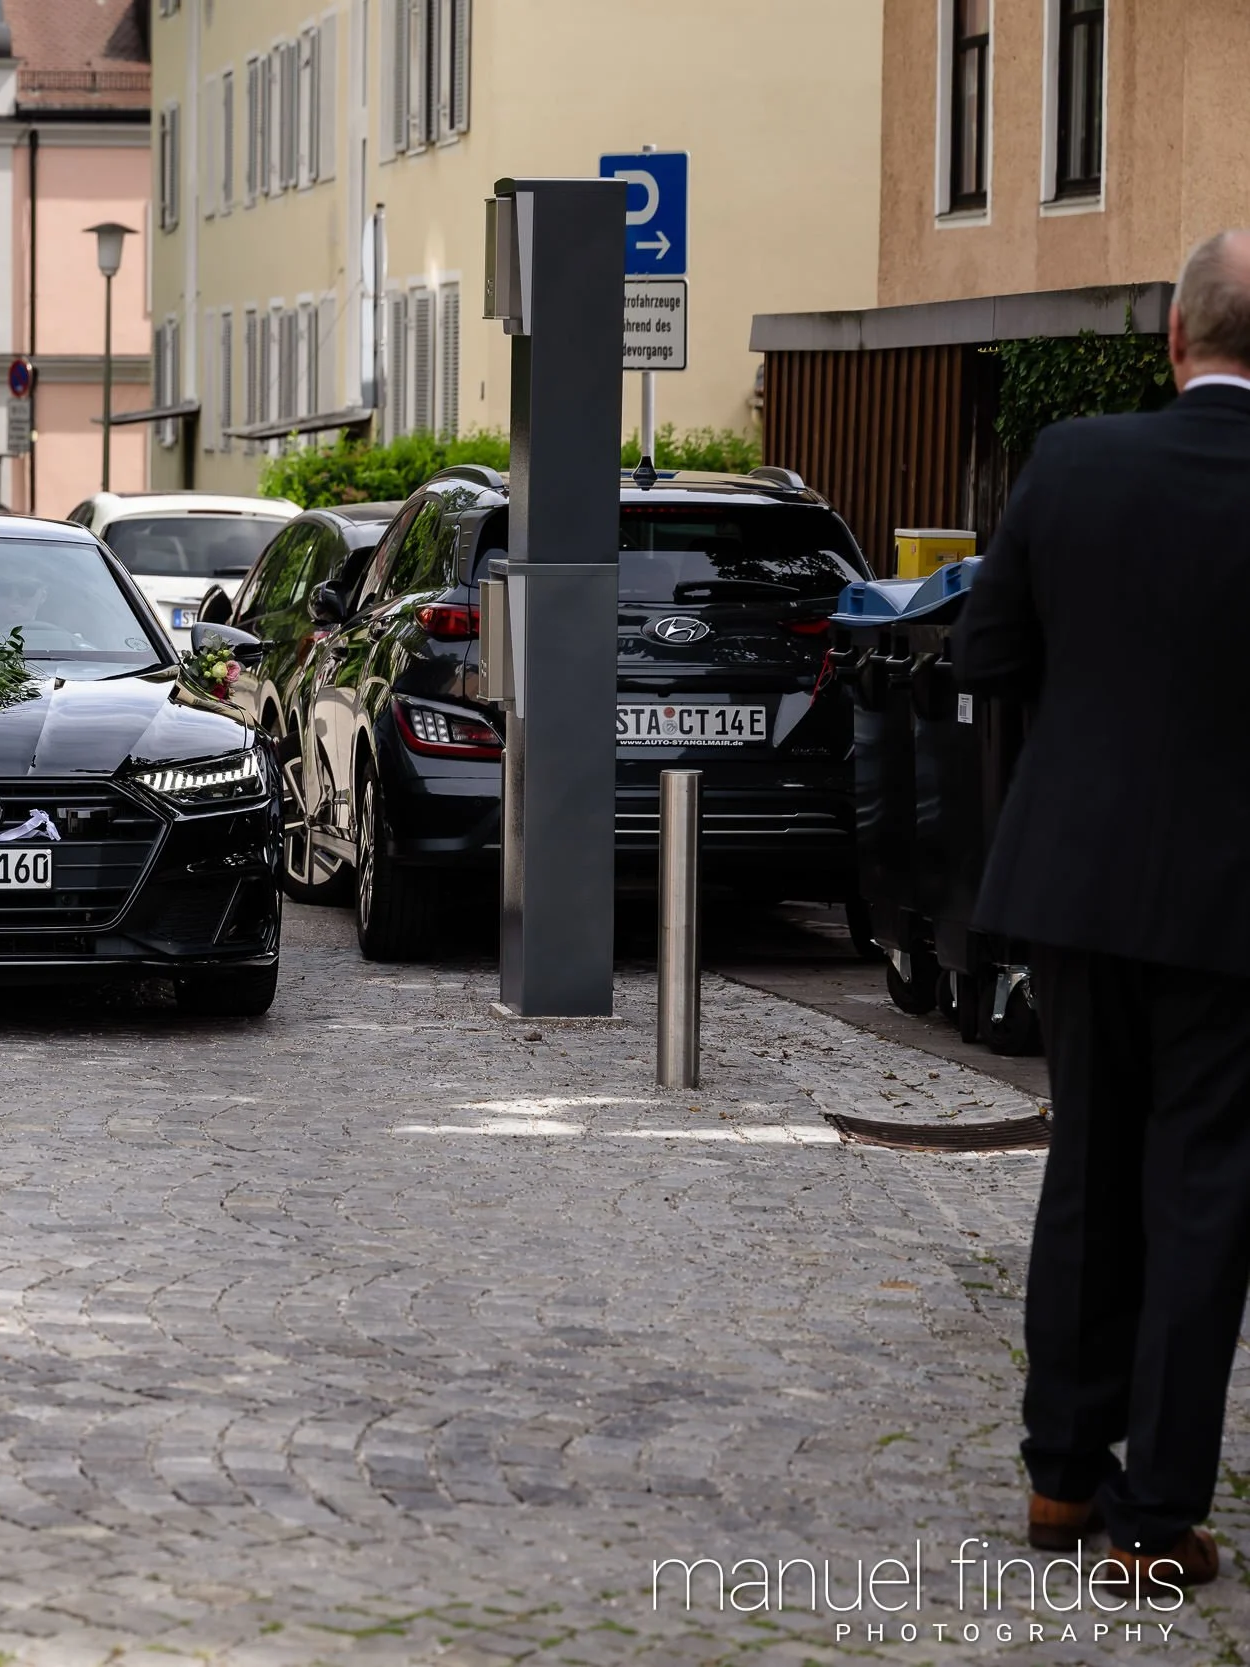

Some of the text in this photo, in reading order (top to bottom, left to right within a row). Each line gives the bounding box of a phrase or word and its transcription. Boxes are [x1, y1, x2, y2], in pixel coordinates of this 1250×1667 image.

[655, 318, 672, 333] des
[616, 708, 661, 735] STA
[678, 708, 709, 735] CT
[619, 739, 744, 747] www.AUTO-STANGLMAIR.de
